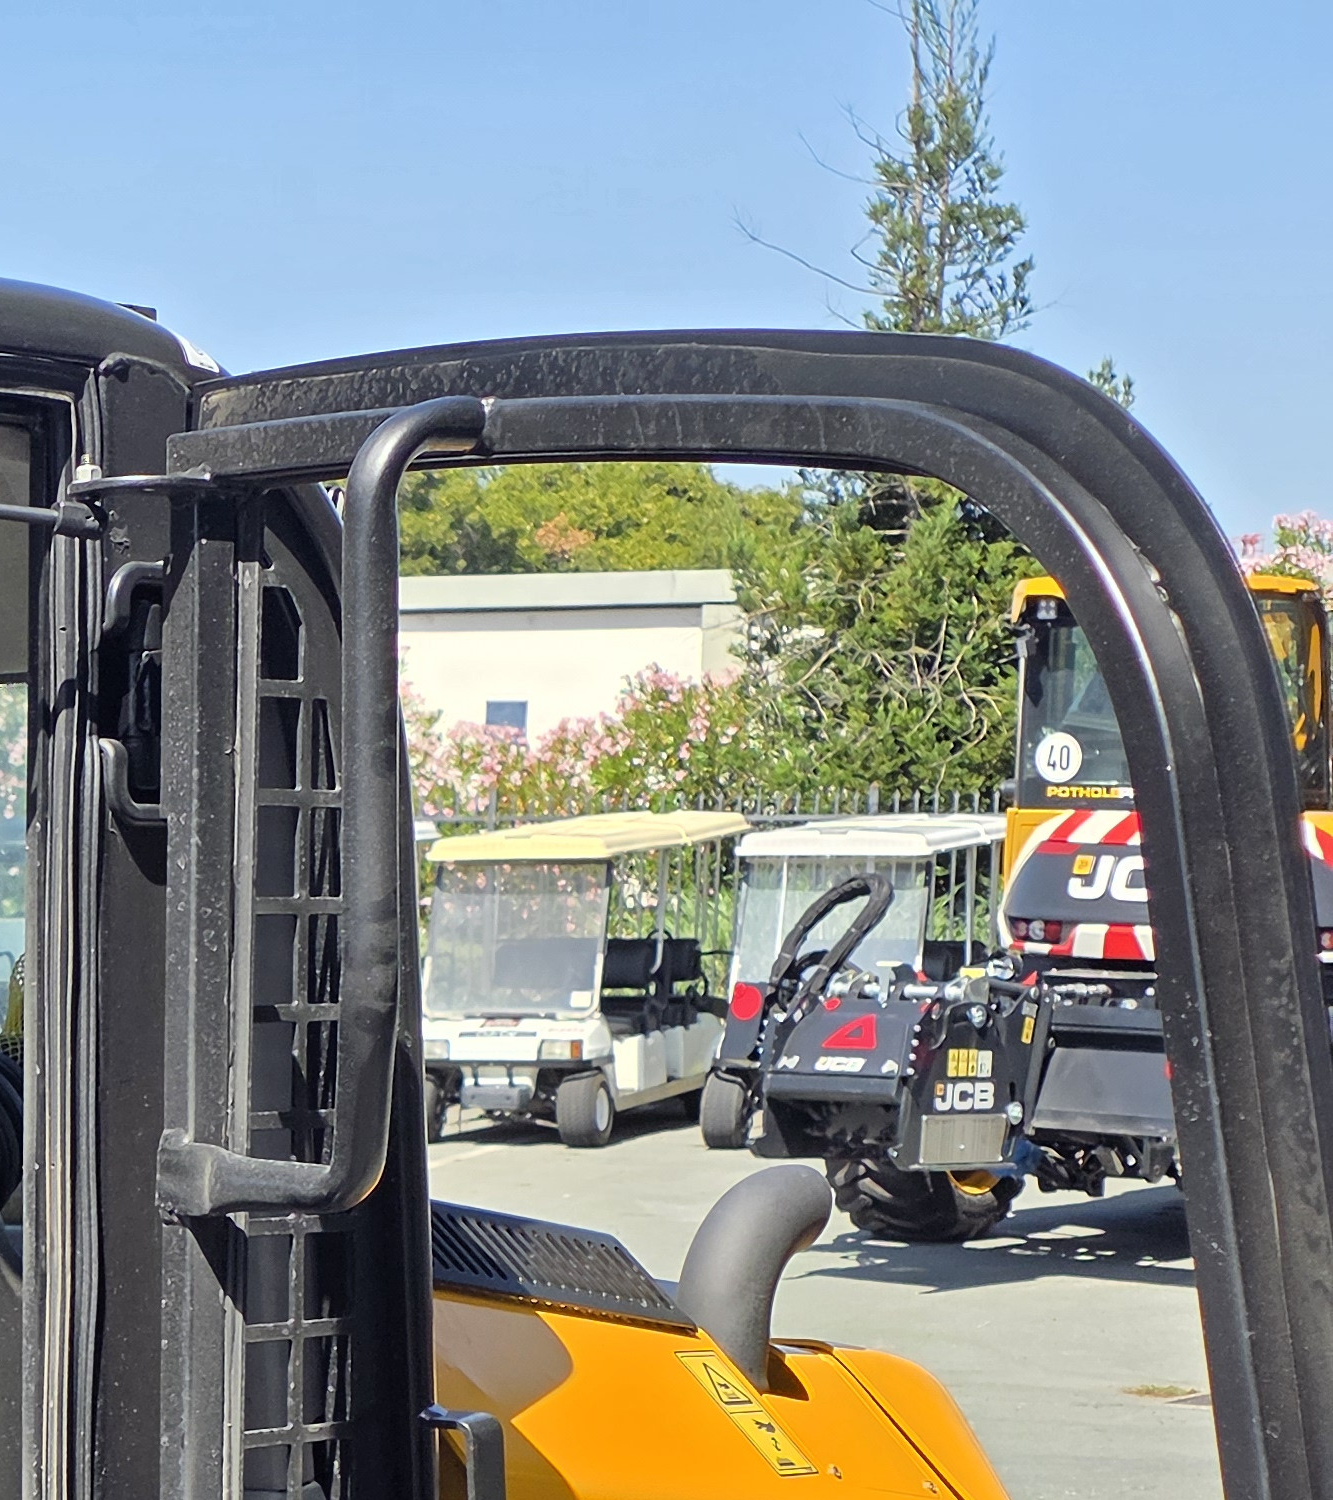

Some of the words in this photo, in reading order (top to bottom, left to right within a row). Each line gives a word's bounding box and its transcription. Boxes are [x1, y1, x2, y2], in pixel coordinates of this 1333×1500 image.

[1047, 744, 1071, 772] 40
[1067, 854, 1149, 903] JC
[935, 1082, 995, 1111] JCB
